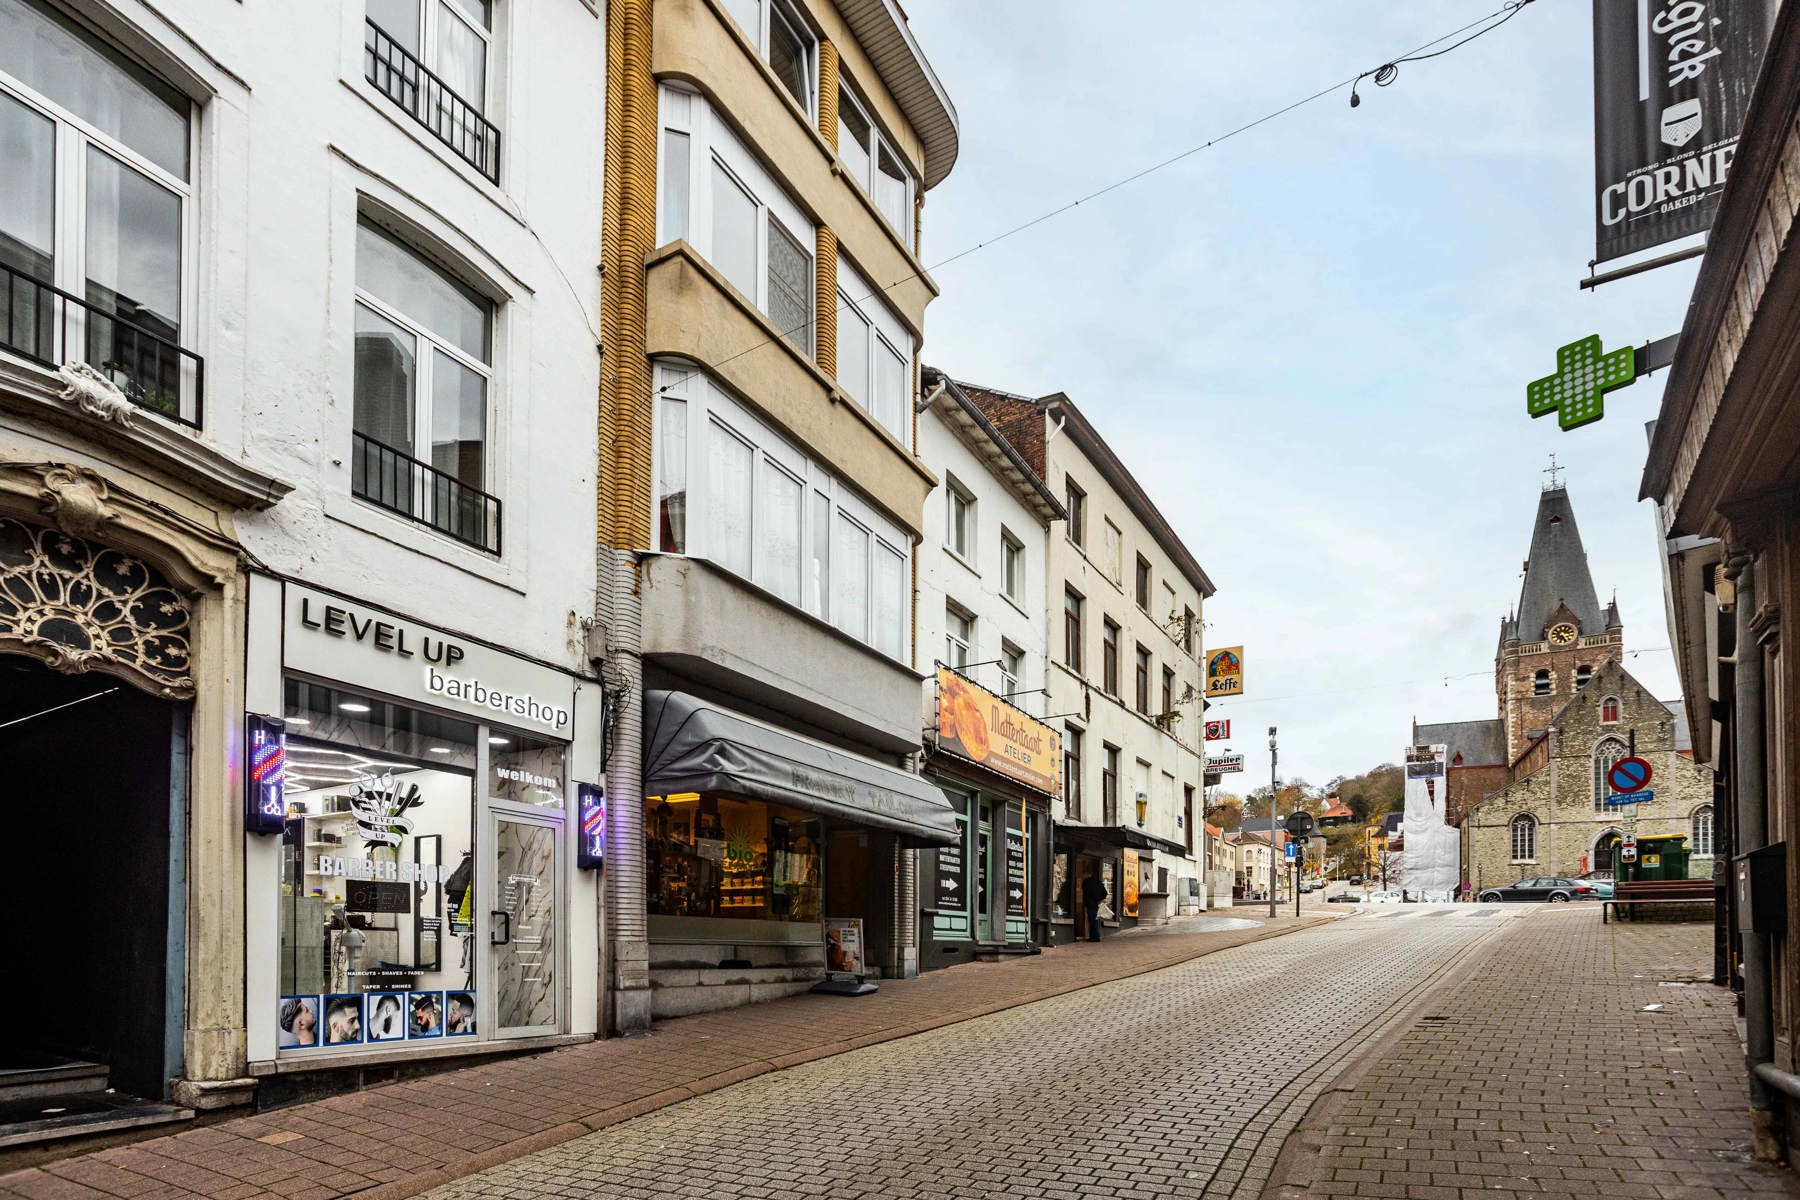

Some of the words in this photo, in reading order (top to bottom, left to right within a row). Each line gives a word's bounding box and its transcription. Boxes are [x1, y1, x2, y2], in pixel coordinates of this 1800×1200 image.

[1626, 162, 1659, 177] STRONG
[1666, 150, 1695, 165] BLOND
[1661, 195, 1697, 214] OAKED
[301, 597, 415, 657] LEVEL
[423, 636, 465, 667] UP
[1210, 678, 1239, 692] Leffe
[428, 667, 569, 727] barbershop
[991, 704, 1043, 756] Mattentaart
[1003, 743, 1032, 765] ATELIER
[1207, 757, 1241, 767] Jupiler
[496, 767, 556, 789] welkom
[368, 815, 397, 825] LEVEL
[319, 855, 397, 881] BARBER
[402, 861, 450, 884] SHOP
[353, 890, 407, 905] OPEN
